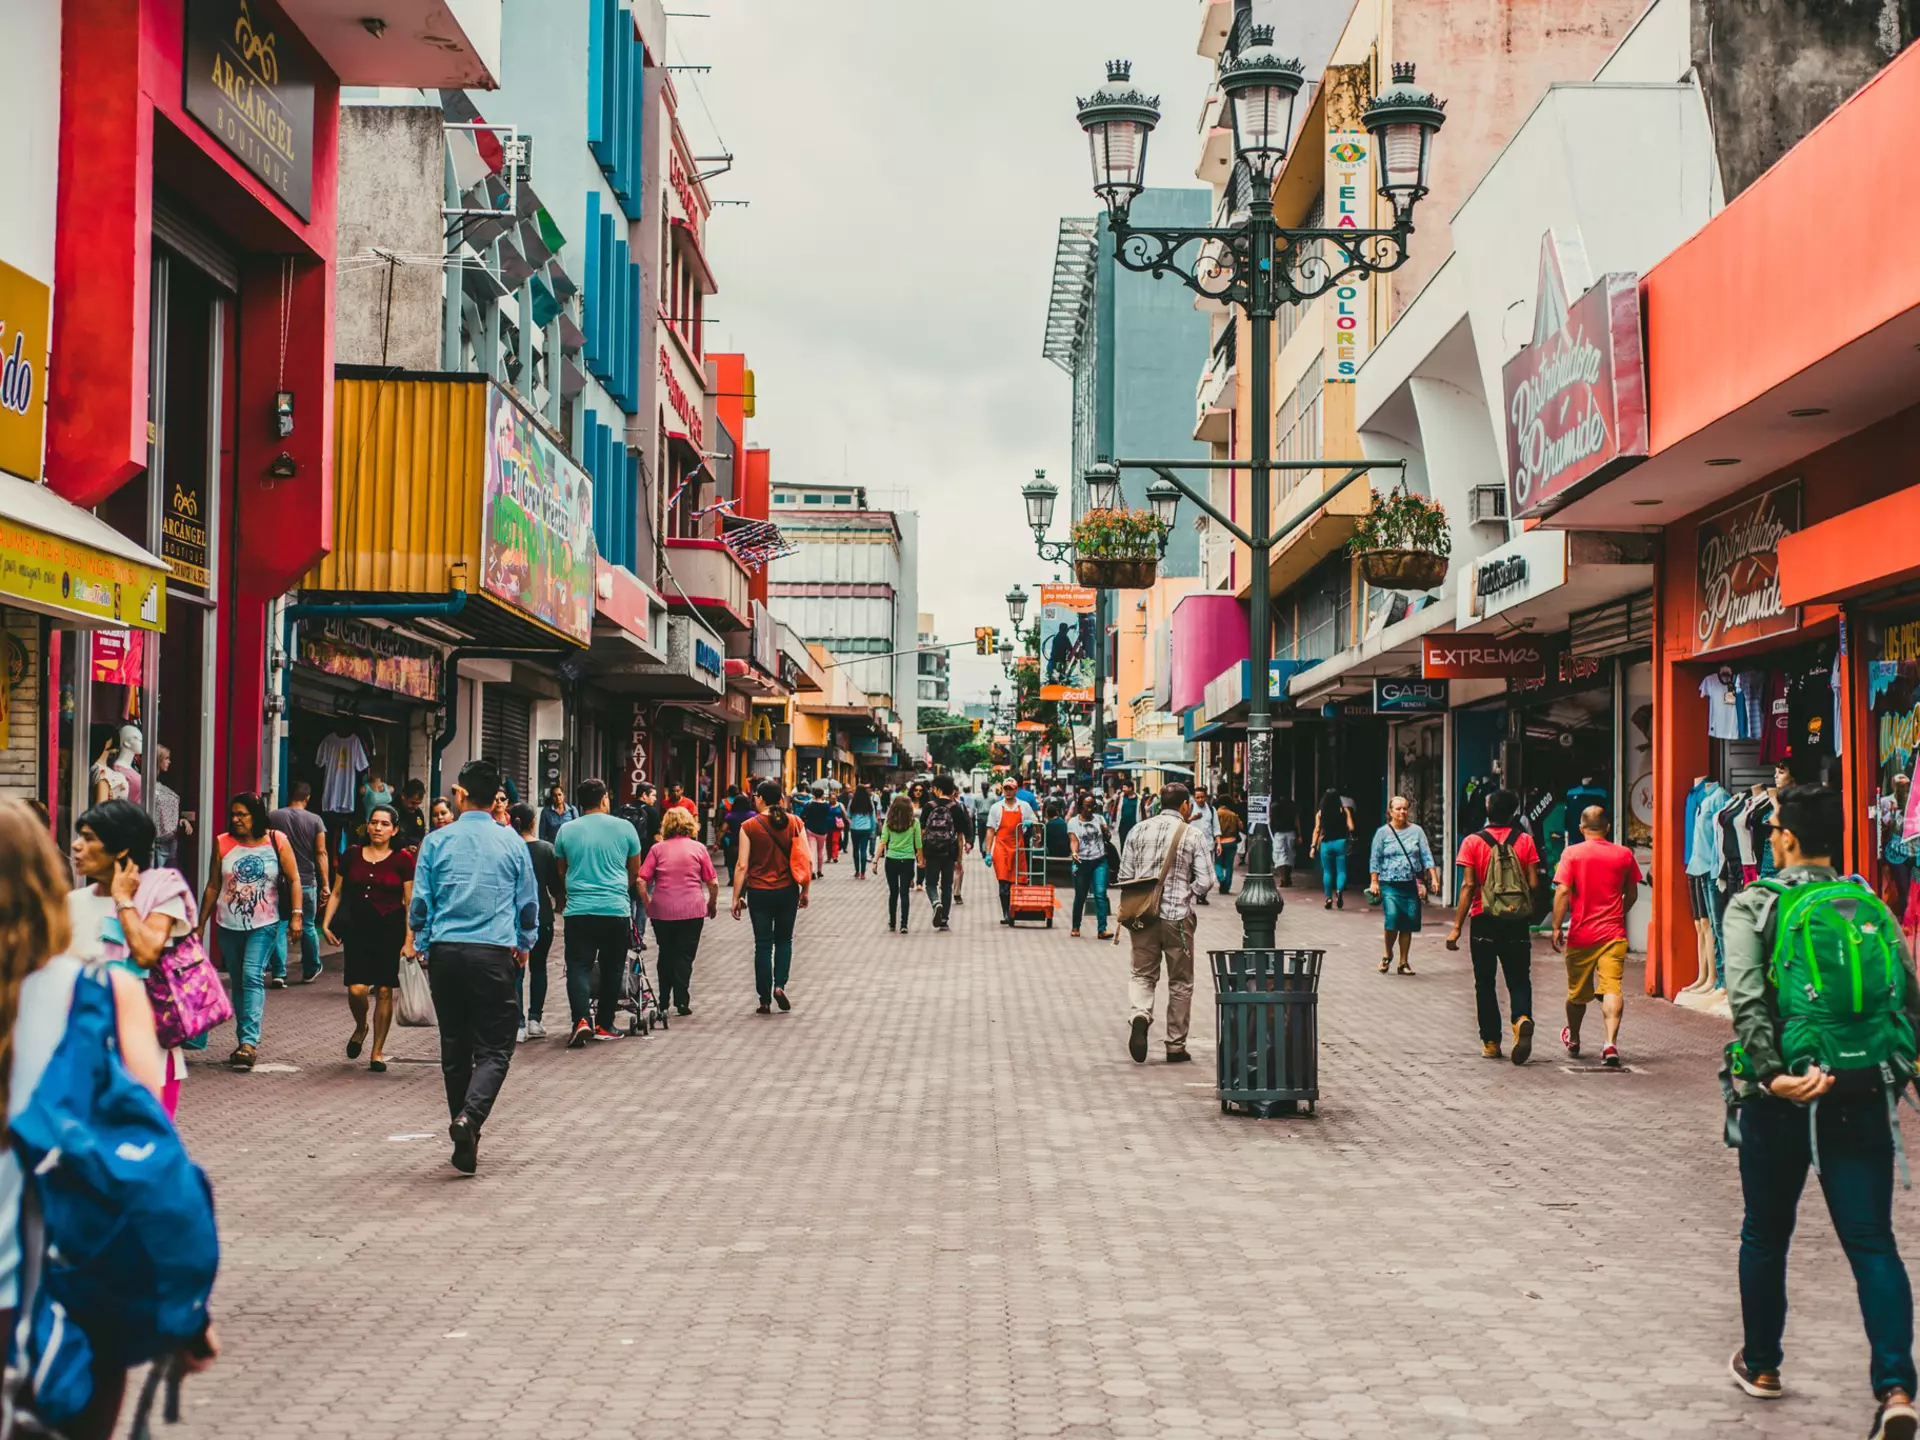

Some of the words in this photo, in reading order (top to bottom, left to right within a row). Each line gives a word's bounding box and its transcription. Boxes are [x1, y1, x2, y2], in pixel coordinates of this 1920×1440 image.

[212, 52, 295, 161] ARCÁNGEL
[217, 107, 288, 191] BOUTIQUE
[1337, 172, 1357, 238] TELA
[0, 331, 32, 415] do
[1512, 323, 1602, 446] Distribuidora
[162, 517, 207, 547] ARCÁNGEL
[165, 541, 203, 564] BOUTIQUE
[63, 547, 83, 570] SUS
[1429, 646, 1540, 666] EXTREMOS
[1382, 683, 1444, 701] GABU
